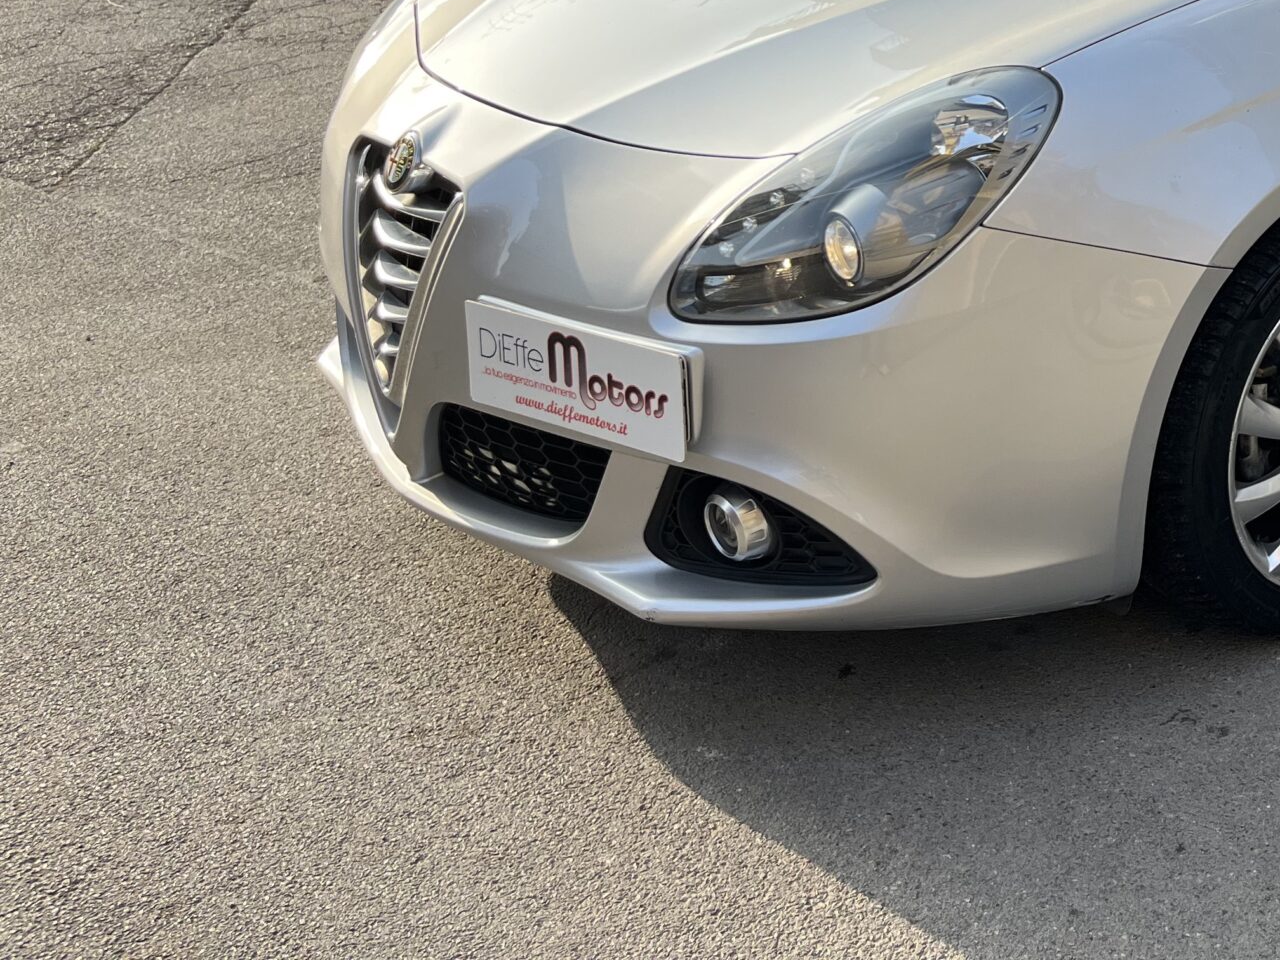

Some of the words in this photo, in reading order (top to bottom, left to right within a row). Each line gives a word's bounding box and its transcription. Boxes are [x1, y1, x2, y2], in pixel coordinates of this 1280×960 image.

[479, 327, 544, 372] DiEffe
[547, 331, 669, 419] Motors
[515, 394, 628, 436] www.dieffemotors.it
